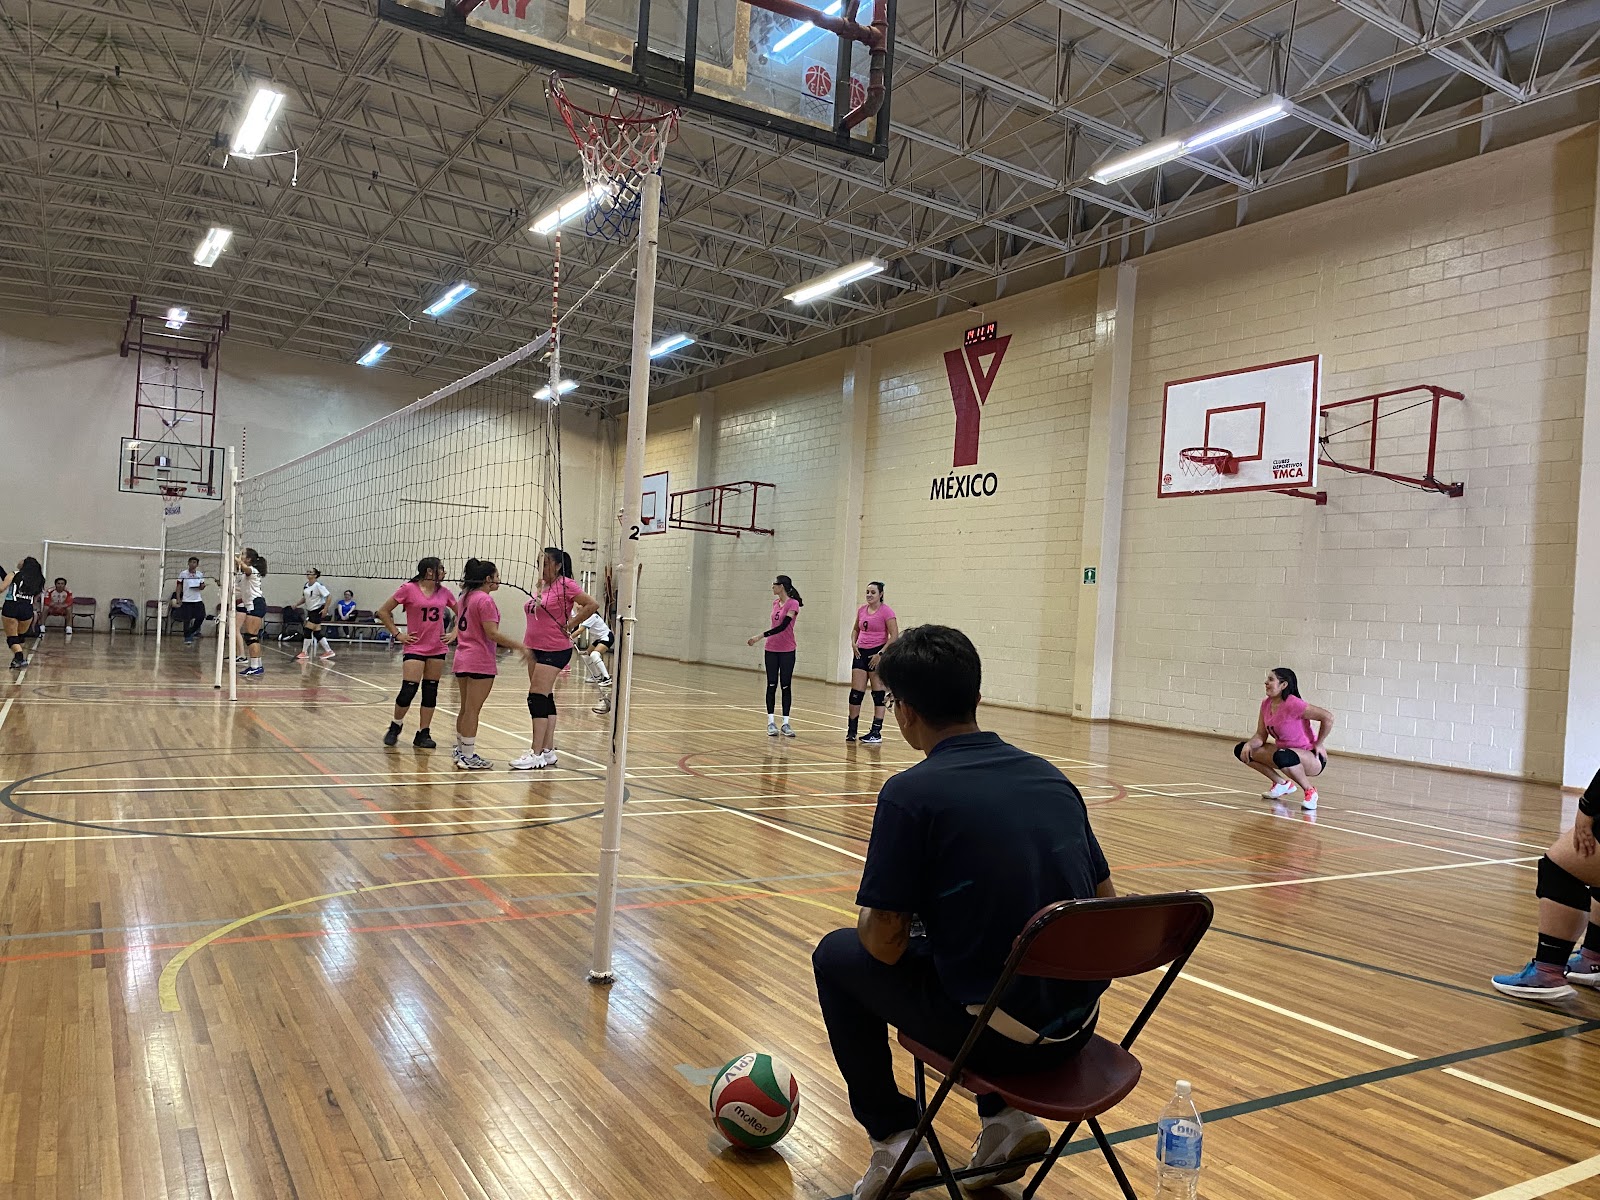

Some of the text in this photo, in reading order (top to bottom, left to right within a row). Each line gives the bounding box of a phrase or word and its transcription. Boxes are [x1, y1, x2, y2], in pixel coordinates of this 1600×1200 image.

[1272, 462, 1303, 470] DEPORTIVOS
[1272, 467, 1303, 480] YMCA
[929, 470, 998, 501] MÉXICO
[628, 525, 640, 540] 2
[420, 607, 440, 622] 13
[458, 607, 468, 632] 6
[774, 611, 780, 621] 5
[862, 621, 869, 632] 9
[724, 1055, 755, 1083] CPLV
[734, 1105, 768, 1134] molten
